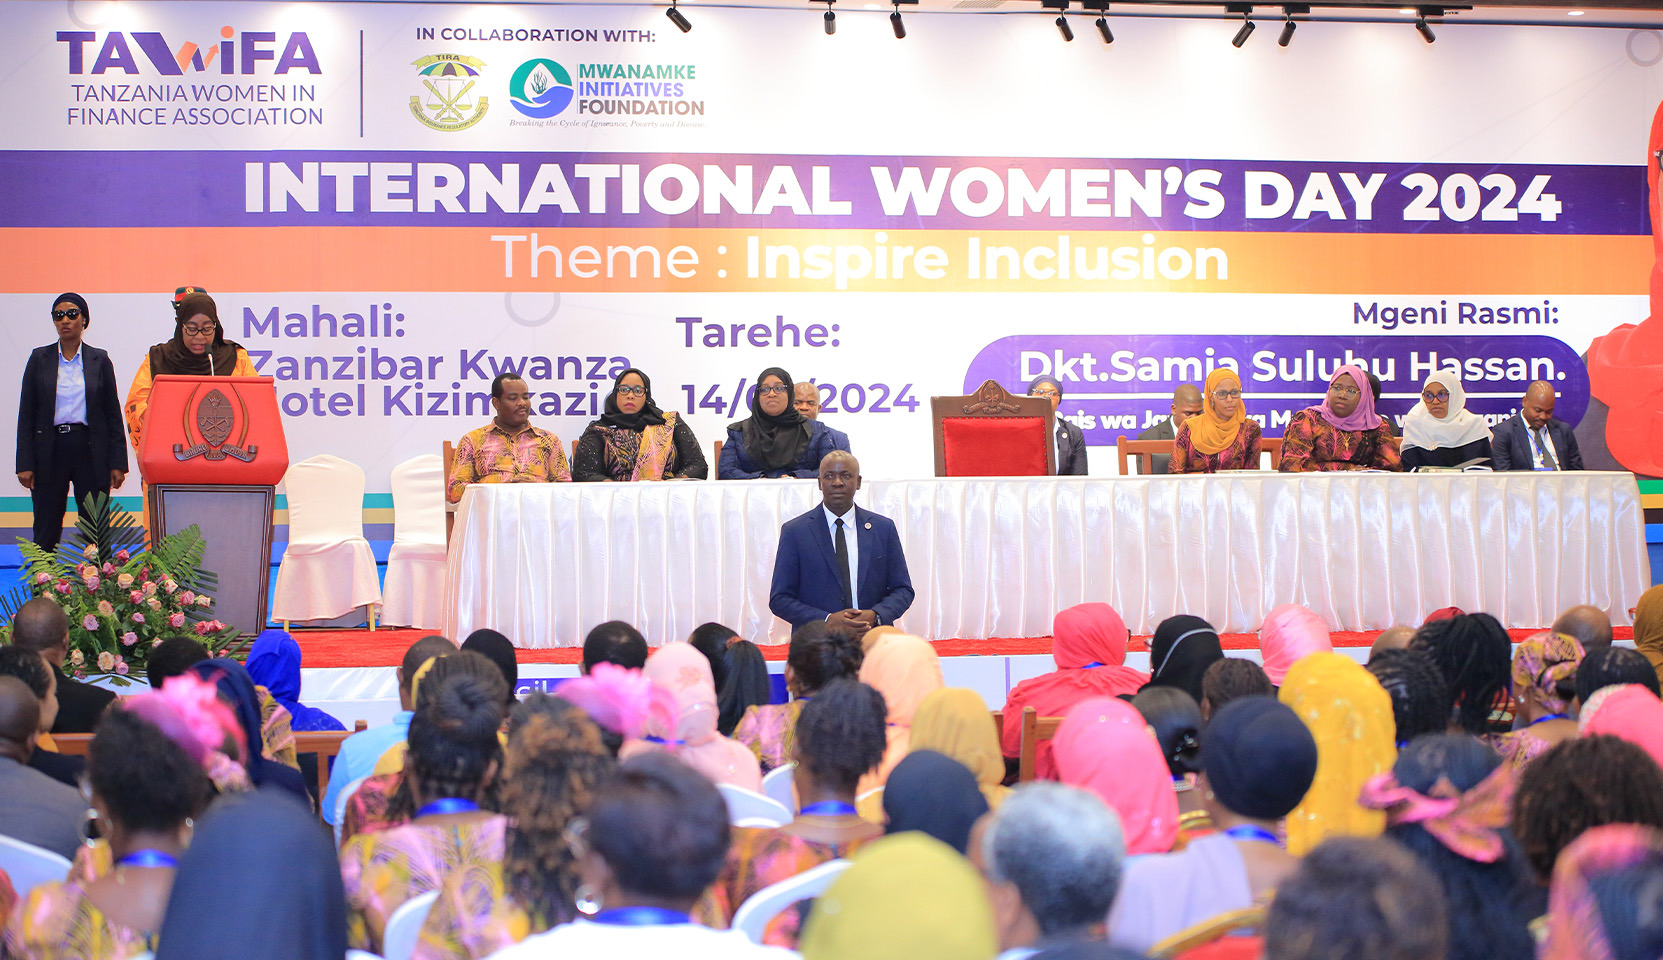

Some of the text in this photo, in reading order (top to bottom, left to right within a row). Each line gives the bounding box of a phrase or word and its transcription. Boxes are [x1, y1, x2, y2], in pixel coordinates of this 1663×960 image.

[416, 28, 656, 42] IN COLLABORATION WITH:
[579, 64, 696, 79] MWANAMKE
[71, 85, 315, 102] TANZANIA WOMEN IN
[579, 82, 684, 97] INITIATIVES
[67, 108, 323, 125] FINANCE ASSOCIATION
[579, 100, 705, 115] FOUNDATION
[509, 119, 544, 128] Breaking
[546, 119, 558, 127] the
[559, 119, 580, 128] Cycle
[581, 119, 590, 128] of
[630, 120, 658, 129] Poverty
[245, 162, 1562, 222] INTERNATIONAL WOMEN’S DAY 2024
[491, 233, 699, 278] Theme
[747, 232, 949, 290] Inspire
[968, 233, 1228, 280] Inclusion
[242, 303, 405, 338] Mahali:
[1354, 300, 1559, 330] Mgeni Rasmi:
[676, 315, 840, 347] Tarehe:
[247, 345, 631, 380] Zanzibar Kwanza
[1410, 352, 1566, 381] Hassan.
[274, 384, 365, 416] otel
[1100, 415, 1137, 430] wa
